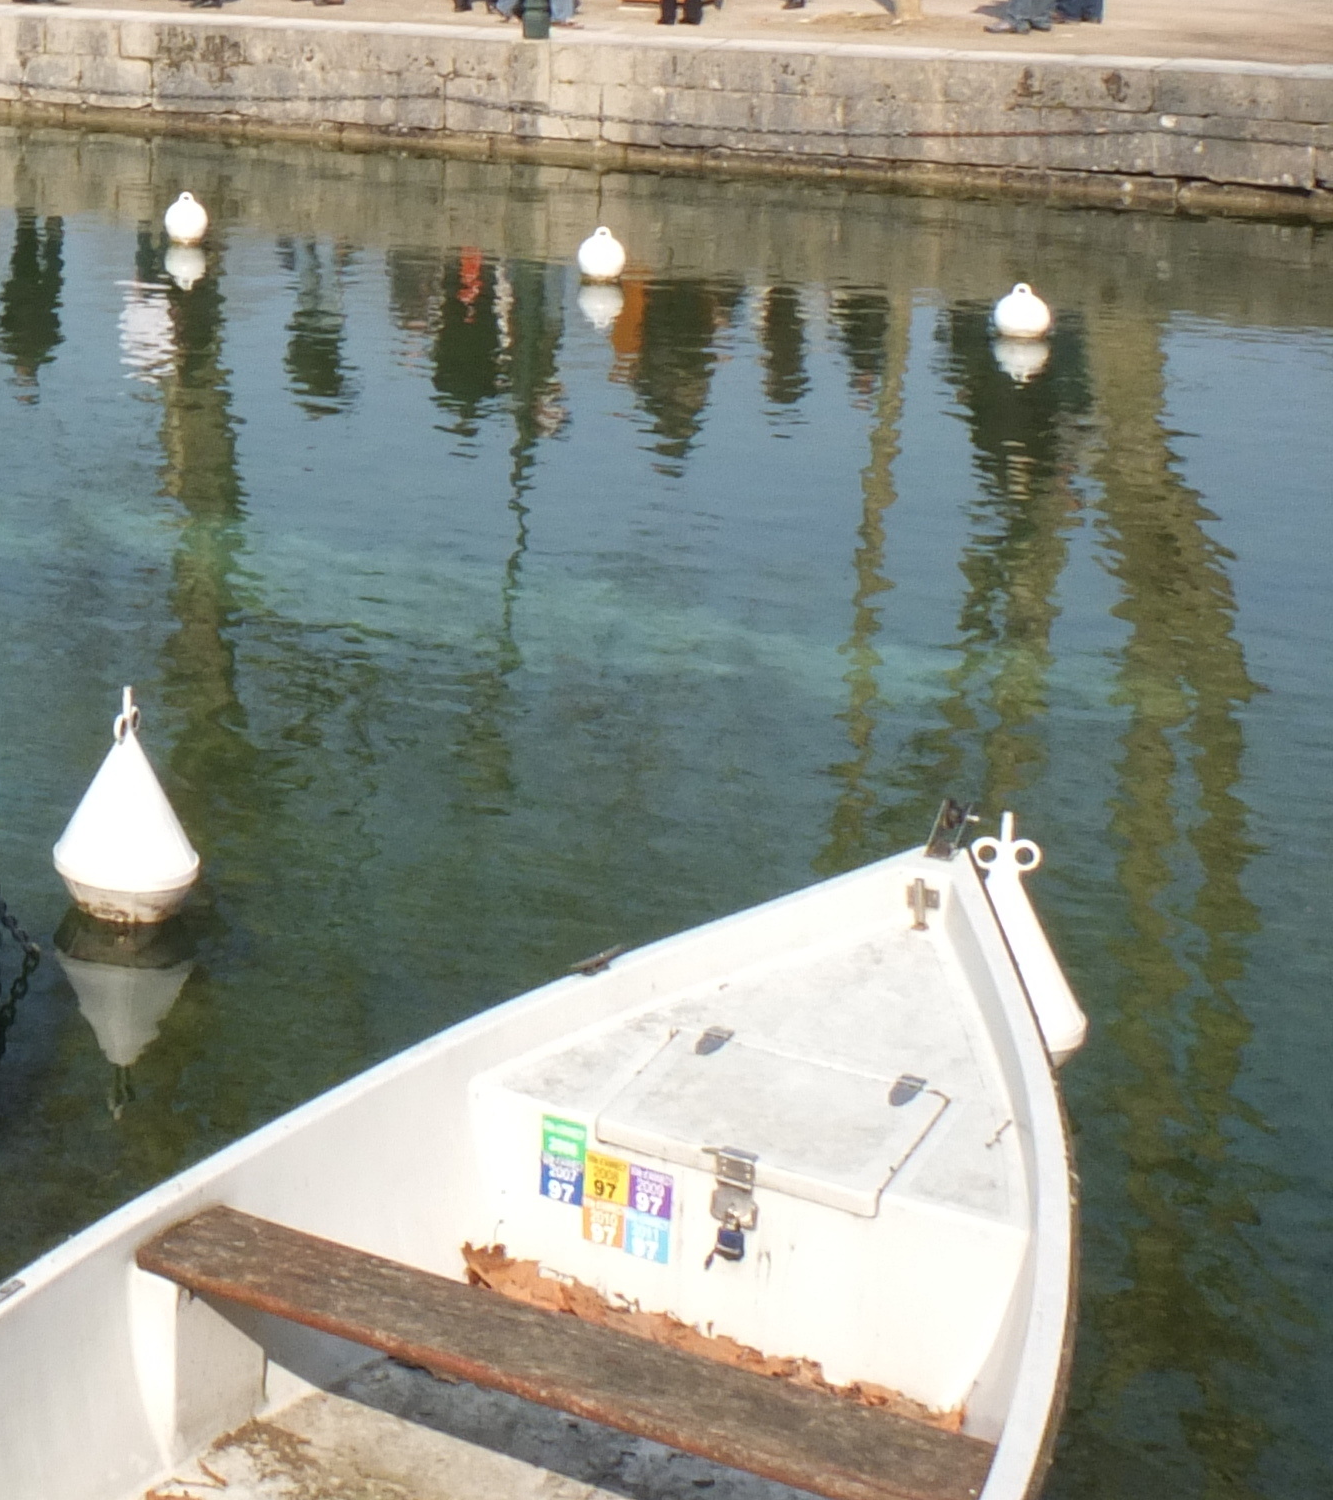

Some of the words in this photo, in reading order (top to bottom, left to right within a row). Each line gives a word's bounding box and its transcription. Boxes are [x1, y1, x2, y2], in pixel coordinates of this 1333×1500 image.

[548, 1180, 575, 1203] 97
[594, 1179, 617, 1199] 97
[636, 1192, 663, 1215] 97
[590, 1223, 617, 1246] 97
[631, 1237, 659, 1260] 97
